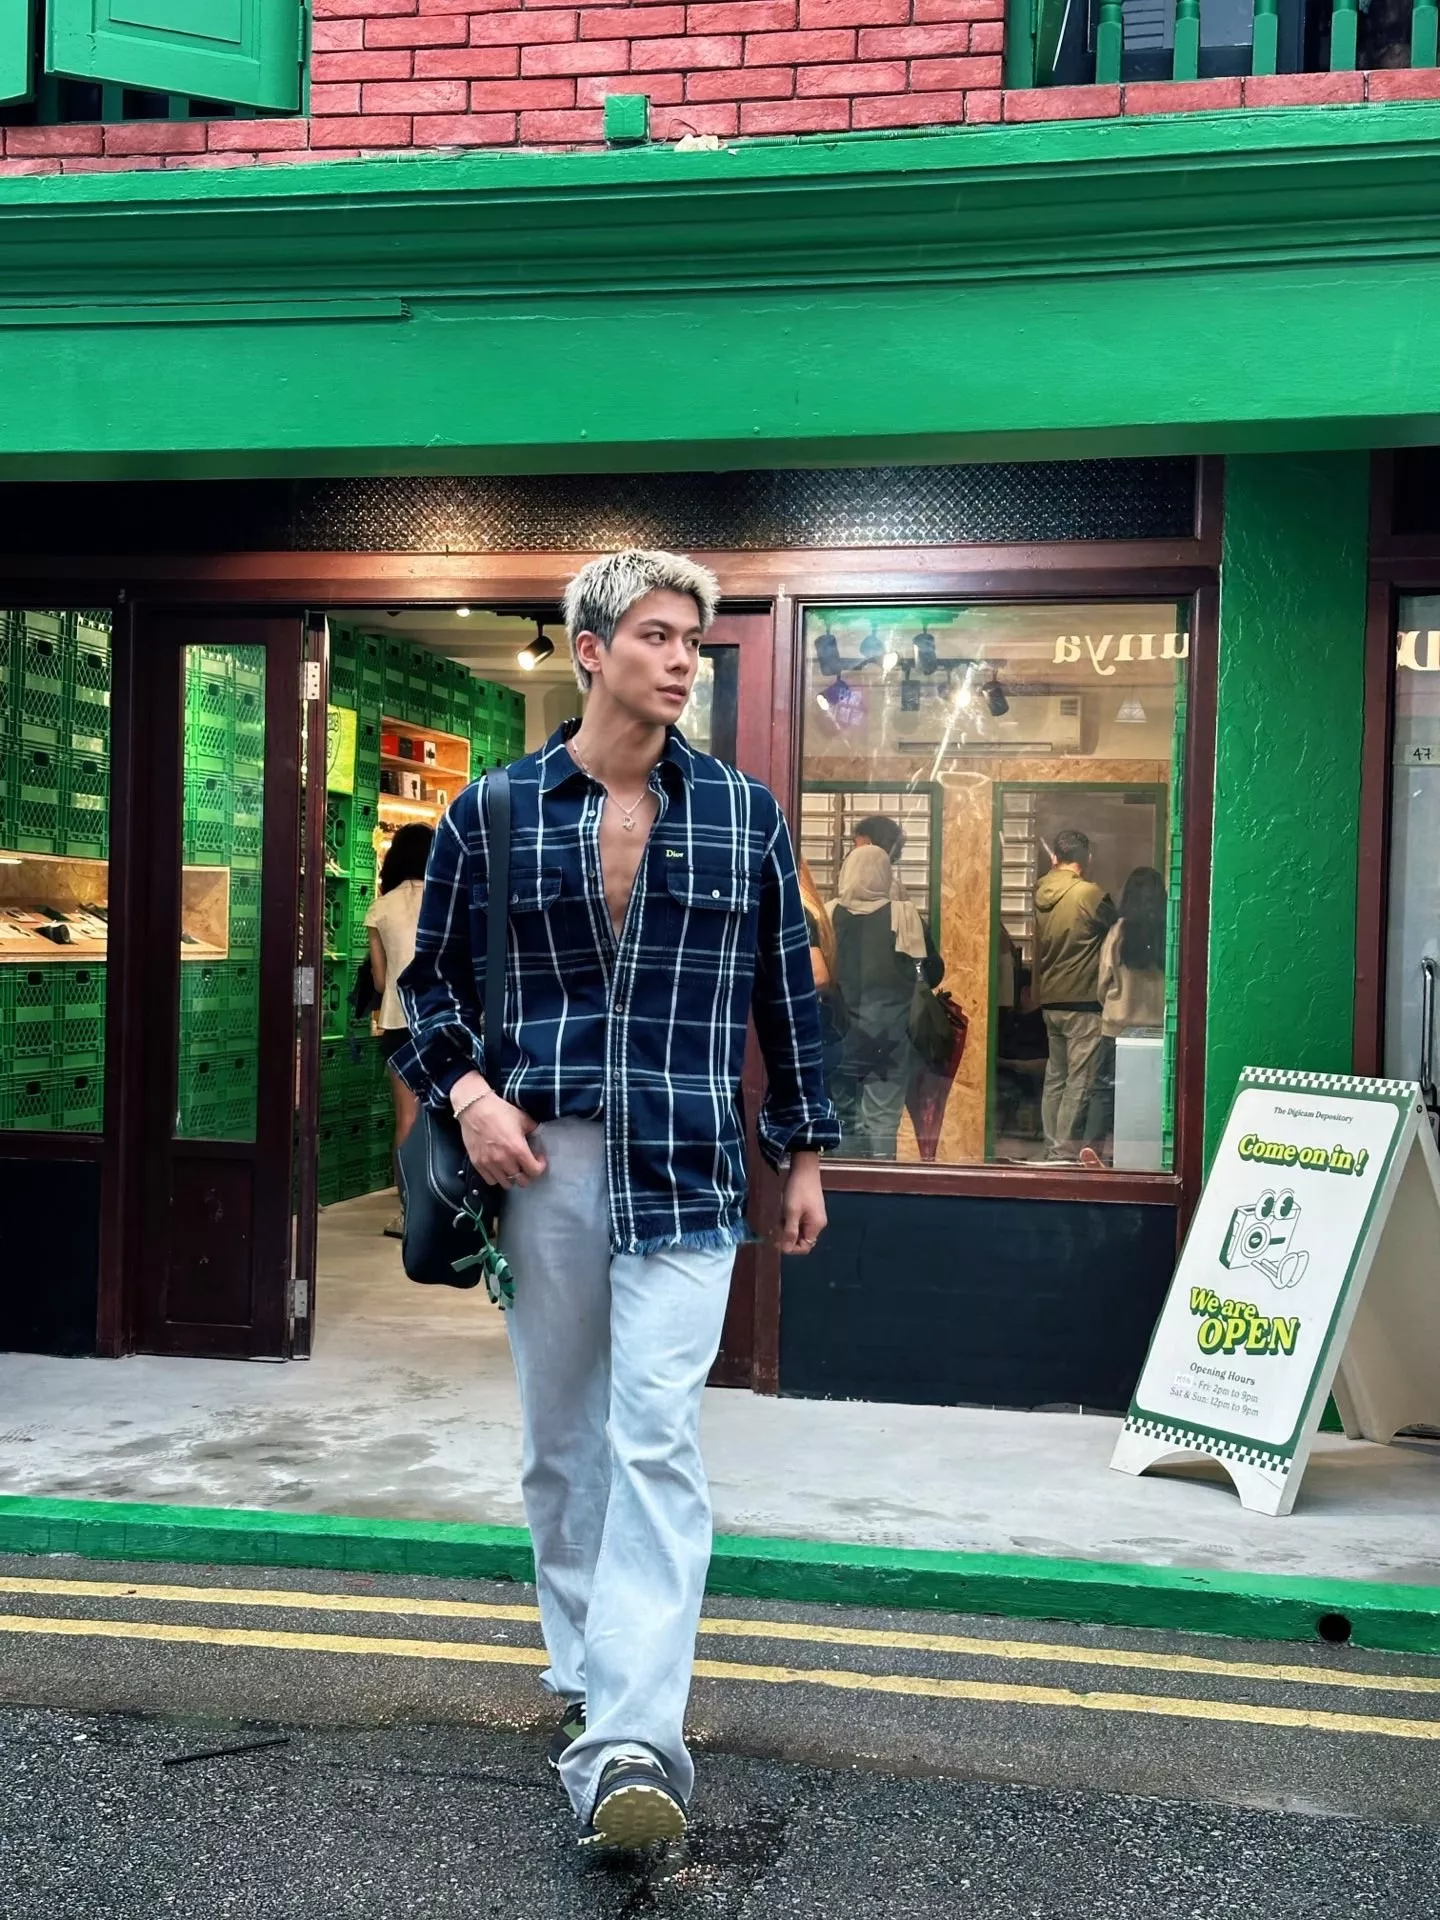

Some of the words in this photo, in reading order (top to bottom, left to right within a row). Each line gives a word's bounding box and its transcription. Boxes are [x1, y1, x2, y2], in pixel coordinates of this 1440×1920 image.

[1413, 747, 1431, 760] 47
[665, 849, 684, 858] Dior
[1274, 1106, 1286, 1115] The
[1287, 1108, 1315, 1118] Digicam
[1315, 1111, 1353, 1124] Depository
[1238, 1134, 1298, 1167] Come
[1299, 1147, 1329, 1171] on
[1190, 1286, 1220, 1317] We
[1220, 1299, 1259, 1321] are
[1198, 1316, 1301, 1356] OPEN
[1190, 1362, 1227, 1380] Opening
[1228, 1370, 1256, 1386] Hours
[1170, 1387, 1183, 1397] Sat
[1184, 1391, 1190, 1399] &
[1191, 1392, 1210, 1403] Sun:
[1210, 1396, 1230, 1410] 12pm
[1231, 1402, 1240, 1411] to
[1241, 1404, 1259, 1417] 9pm
[1212, 1384, 1230, 1396] 2pm
[1231, 1389, 1240, 1398] to
[1241, 1391, 1259, 1403] 9pm
